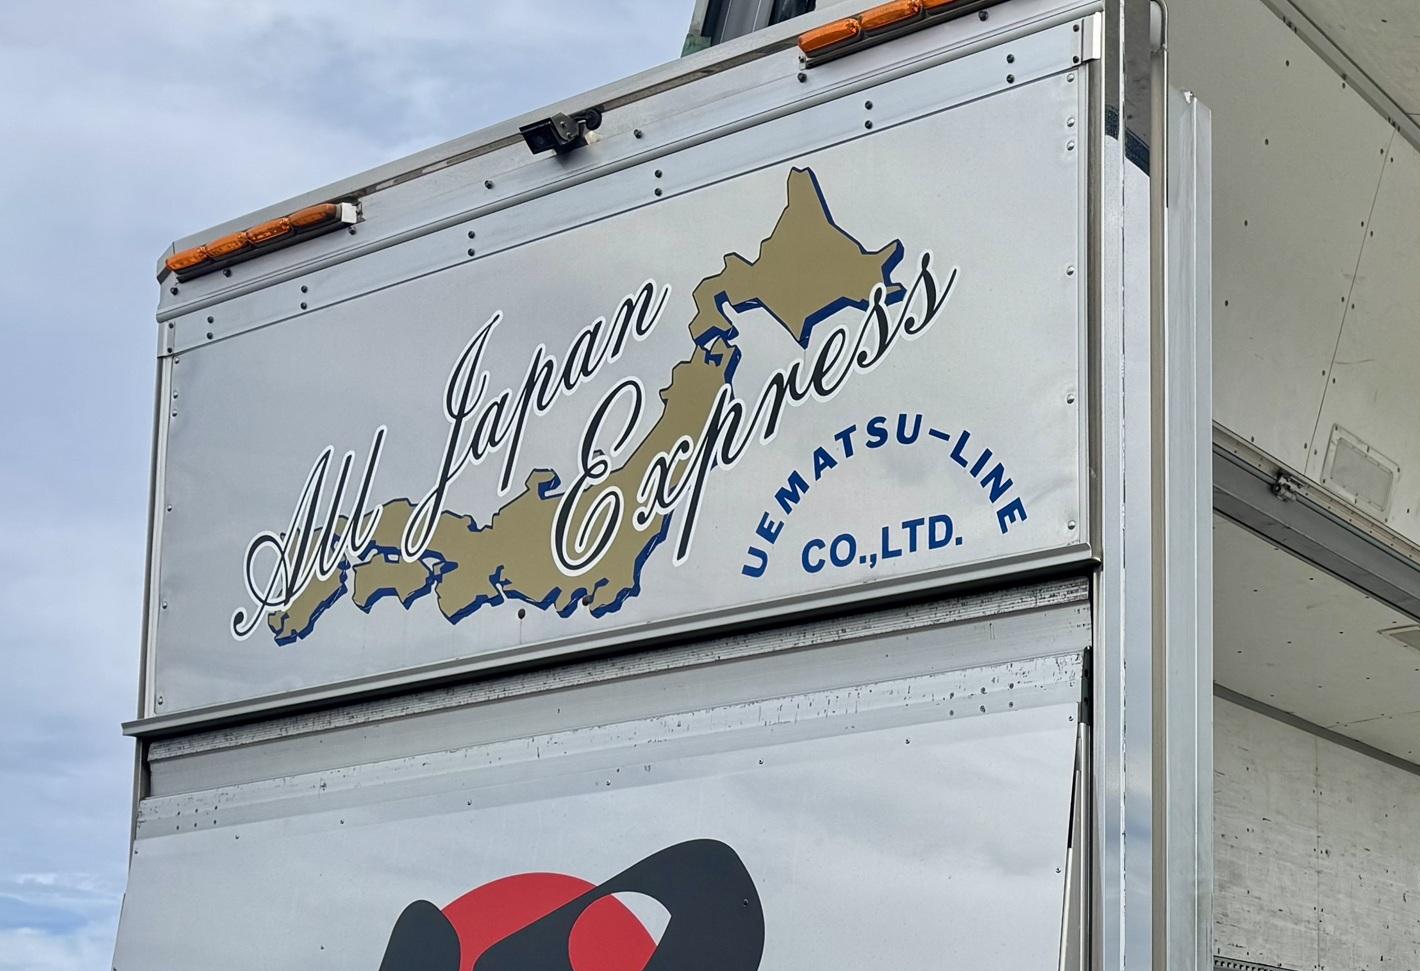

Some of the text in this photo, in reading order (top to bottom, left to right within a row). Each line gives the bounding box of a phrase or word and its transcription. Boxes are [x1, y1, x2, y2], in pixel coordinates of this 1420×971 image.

[232, 278, 669, 640] All Japan
[553, 250, 960, 574] Express
